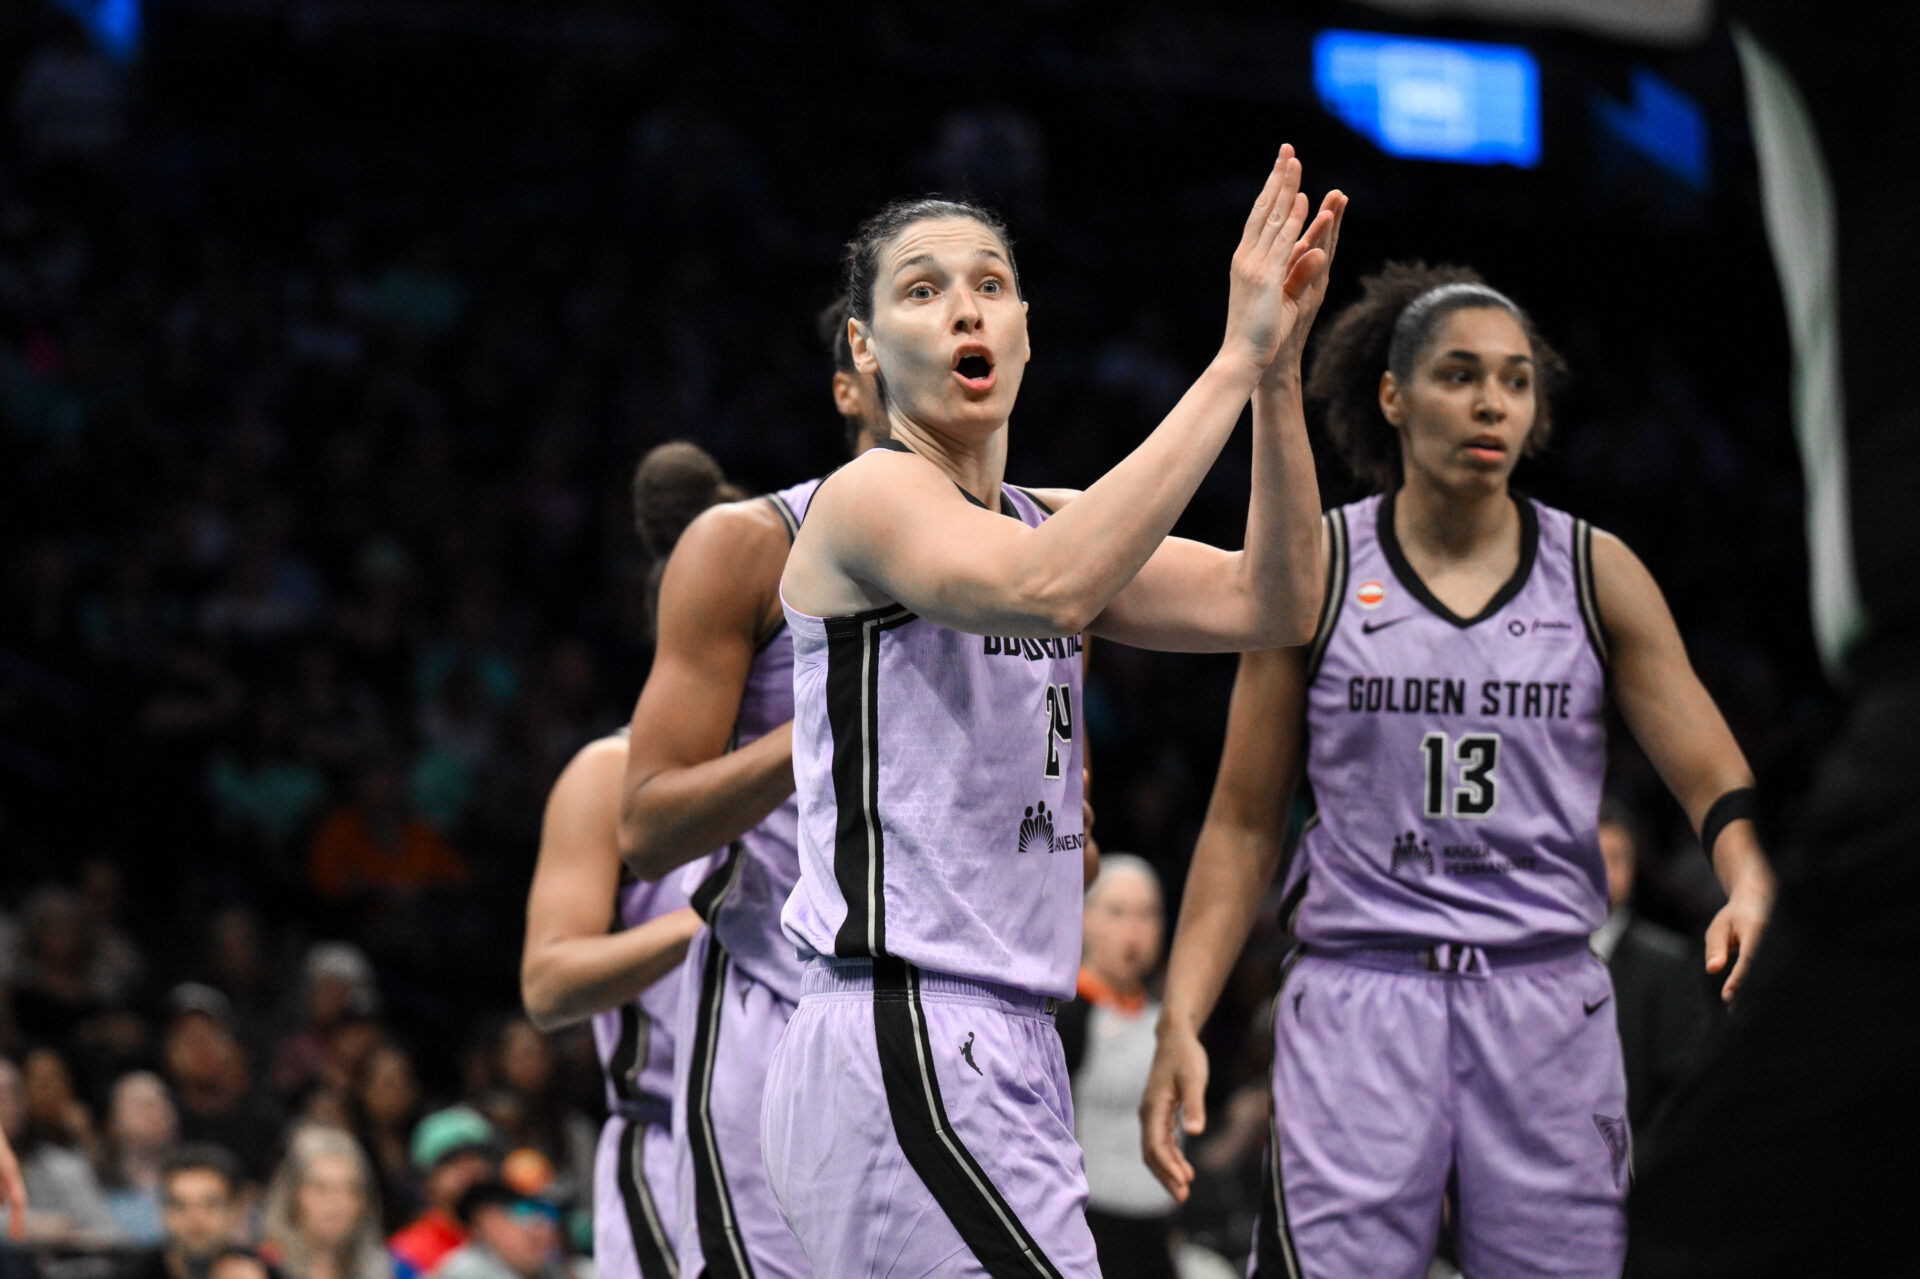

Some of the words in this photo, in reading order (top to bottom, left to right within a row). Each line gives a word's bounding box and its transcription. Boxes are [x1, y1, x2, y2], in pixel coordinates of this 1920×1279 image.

[1044, 682, 1073, 781] 24
[1348, 676, 1466, 715] GOLDEN
[1480, 680, 1571, 719] STATE
[1419, 731, 1501, 820] 13
